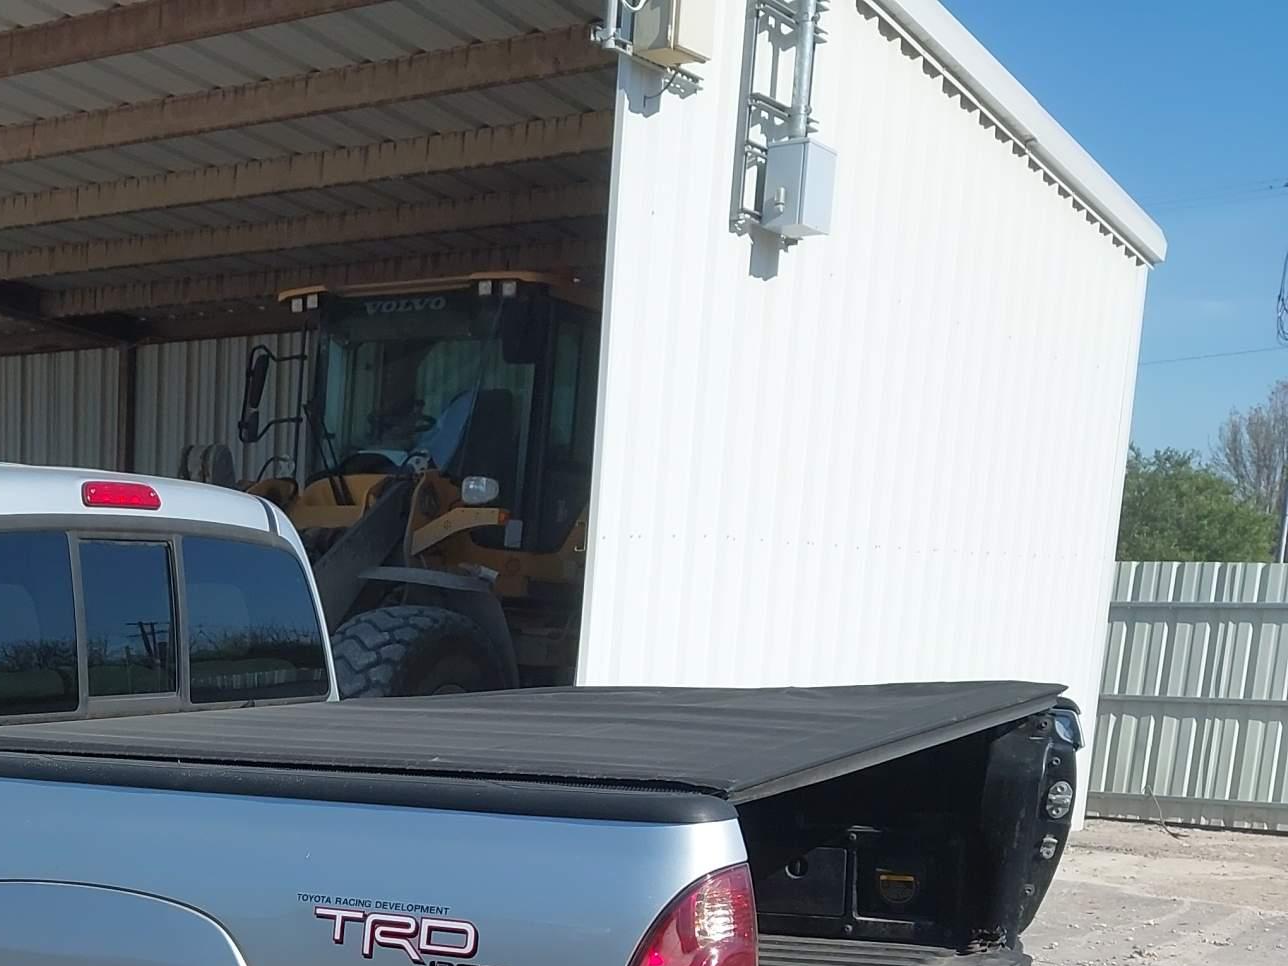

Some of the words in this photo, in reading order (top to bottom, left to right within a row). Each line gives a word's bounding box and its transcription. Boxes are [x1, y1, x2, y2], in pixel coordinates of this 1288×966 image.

[364, 296, 447, 315] VOLVO
[296, 893, 332, 905] TOYOTA
[334, 896, 372, 908] RACING
[374, 900, 450, 916] DEVELOPMENT
[314, 906, 479, 966] TRD
